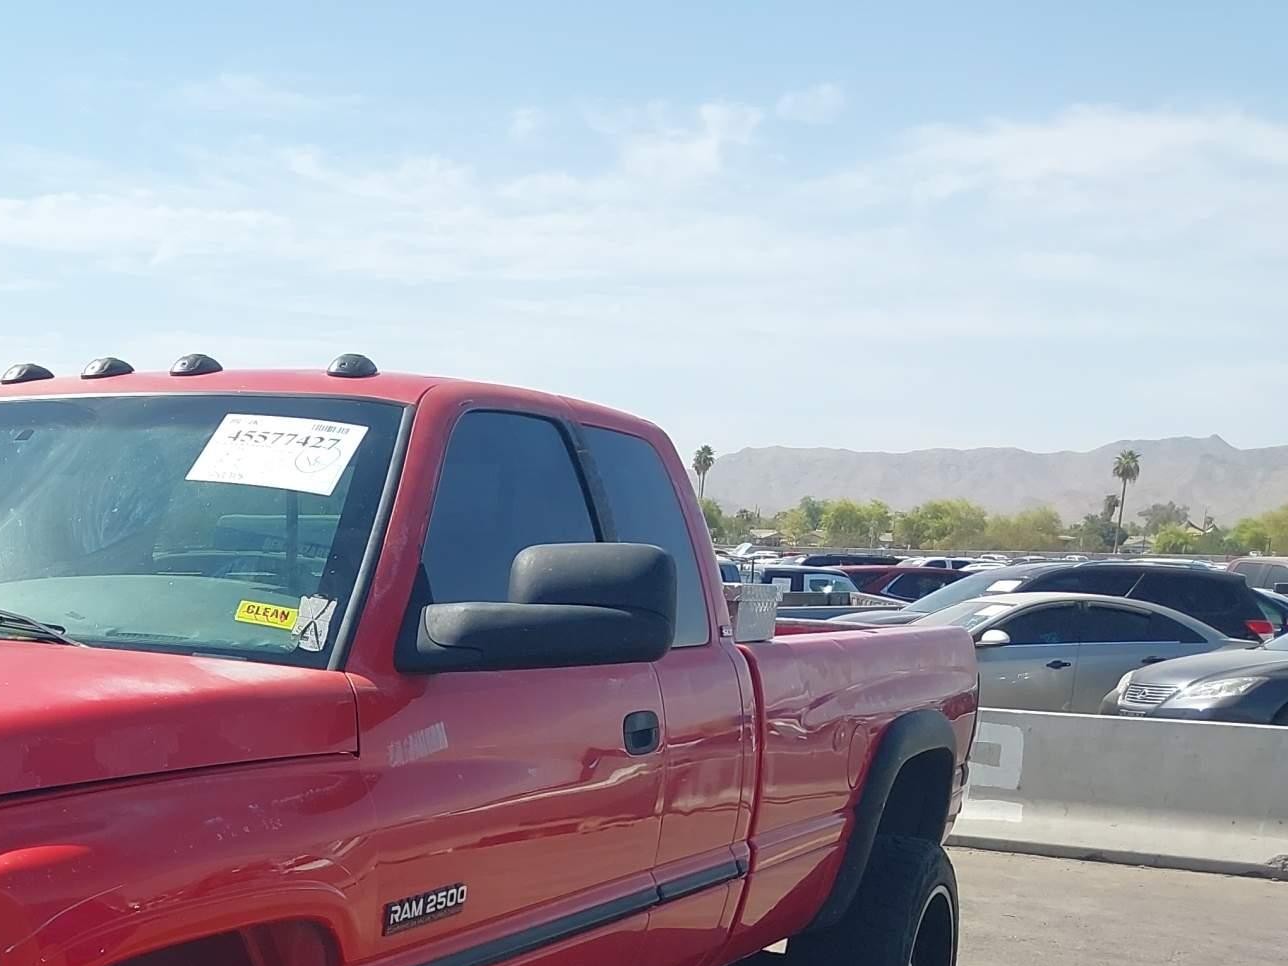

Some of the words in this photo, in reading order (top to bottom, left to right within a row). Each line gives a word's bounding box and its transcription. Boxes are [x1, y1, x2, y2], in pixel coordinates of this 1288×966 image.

[228, 430, 341, 450] 45577427
[246, 605, 290, 621] CLEAN
[390, 898, 424, 924] RAM
[426, 885, 467, 914] 2500
